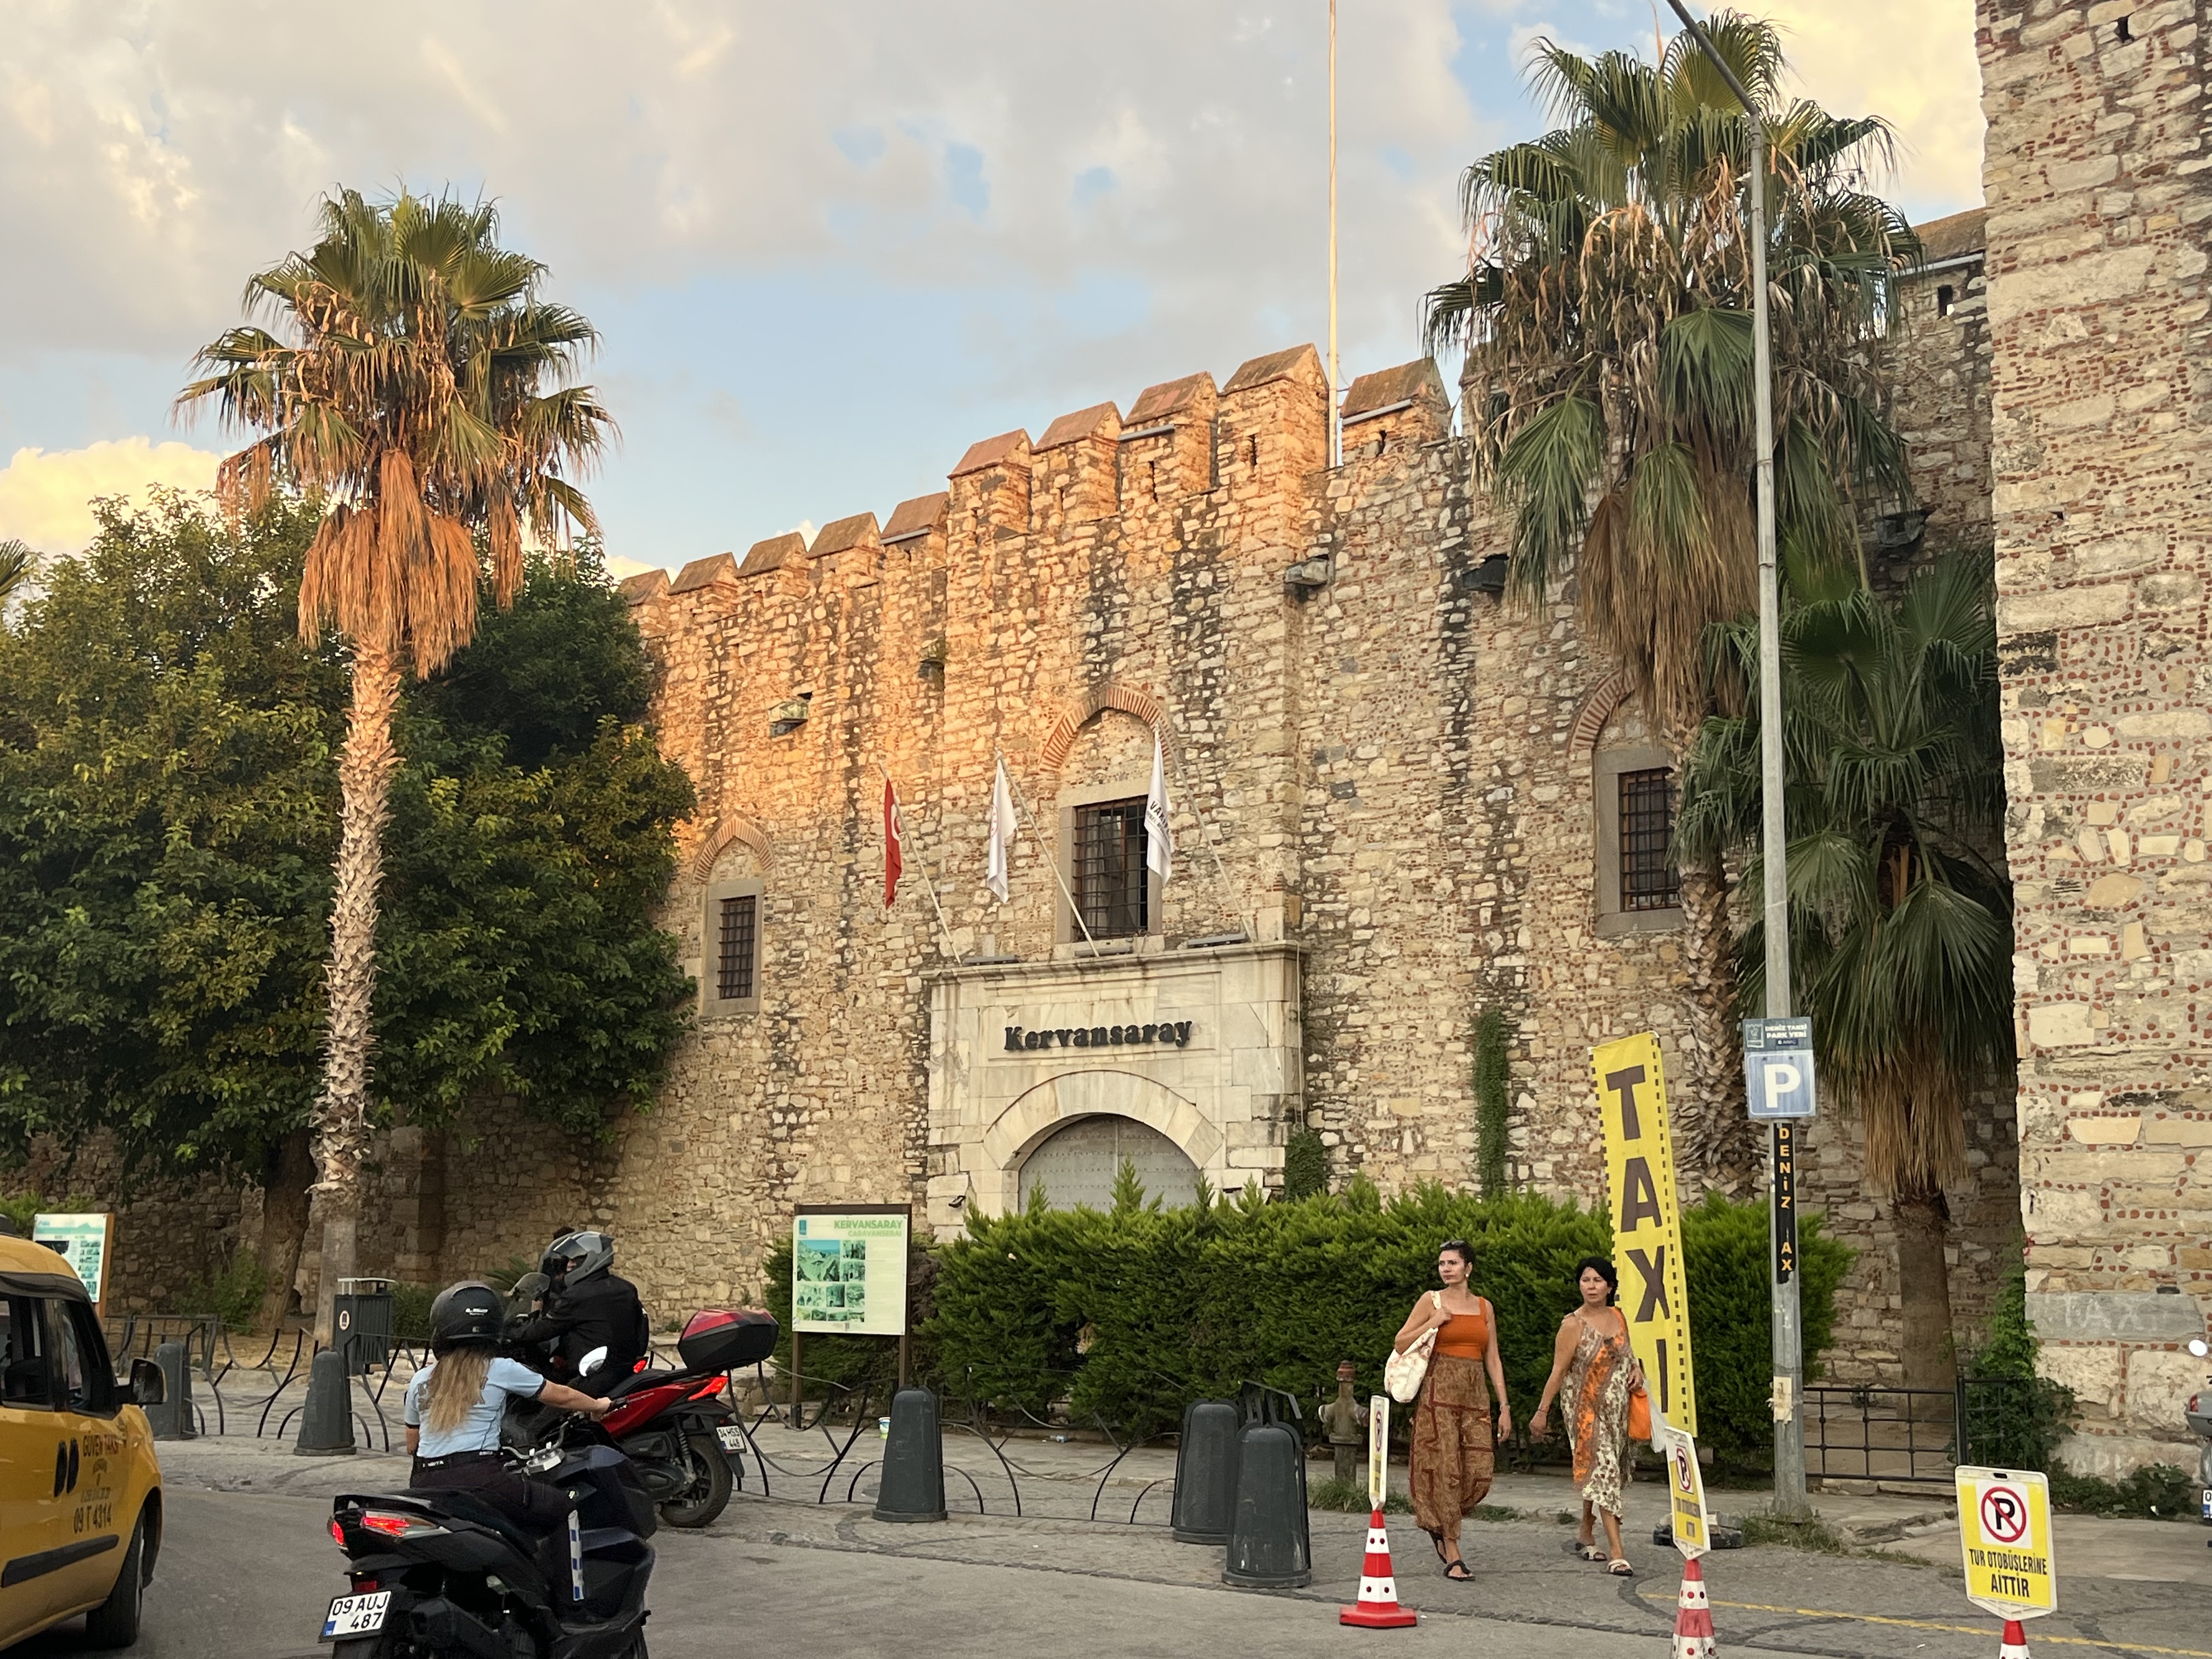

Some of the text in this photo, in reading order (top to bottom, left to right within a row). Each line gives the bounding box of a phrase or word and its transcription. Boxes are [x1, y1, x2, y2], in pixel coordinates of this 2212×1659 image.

[1004, 1021, 1192, 1051] Kervansaray
[1764, 1063, 1801, 1109] P
[1779, 1127, 1791, 1209] DENİZ
[834, 1220, 903, 1229] KERVANSARAY
[1605, 1064, 1671, 1413] TAXI
[87, 1505, 92, 1532] T
[1969, 1548, 2047, 1575] TUR OTOBÜSLERİNE
[1991, 1570, 2029, 1598] AİTTİR
[332, 1594, 388, 1616] 09 AUJ
[350, 1612, 383, 1629] 487
